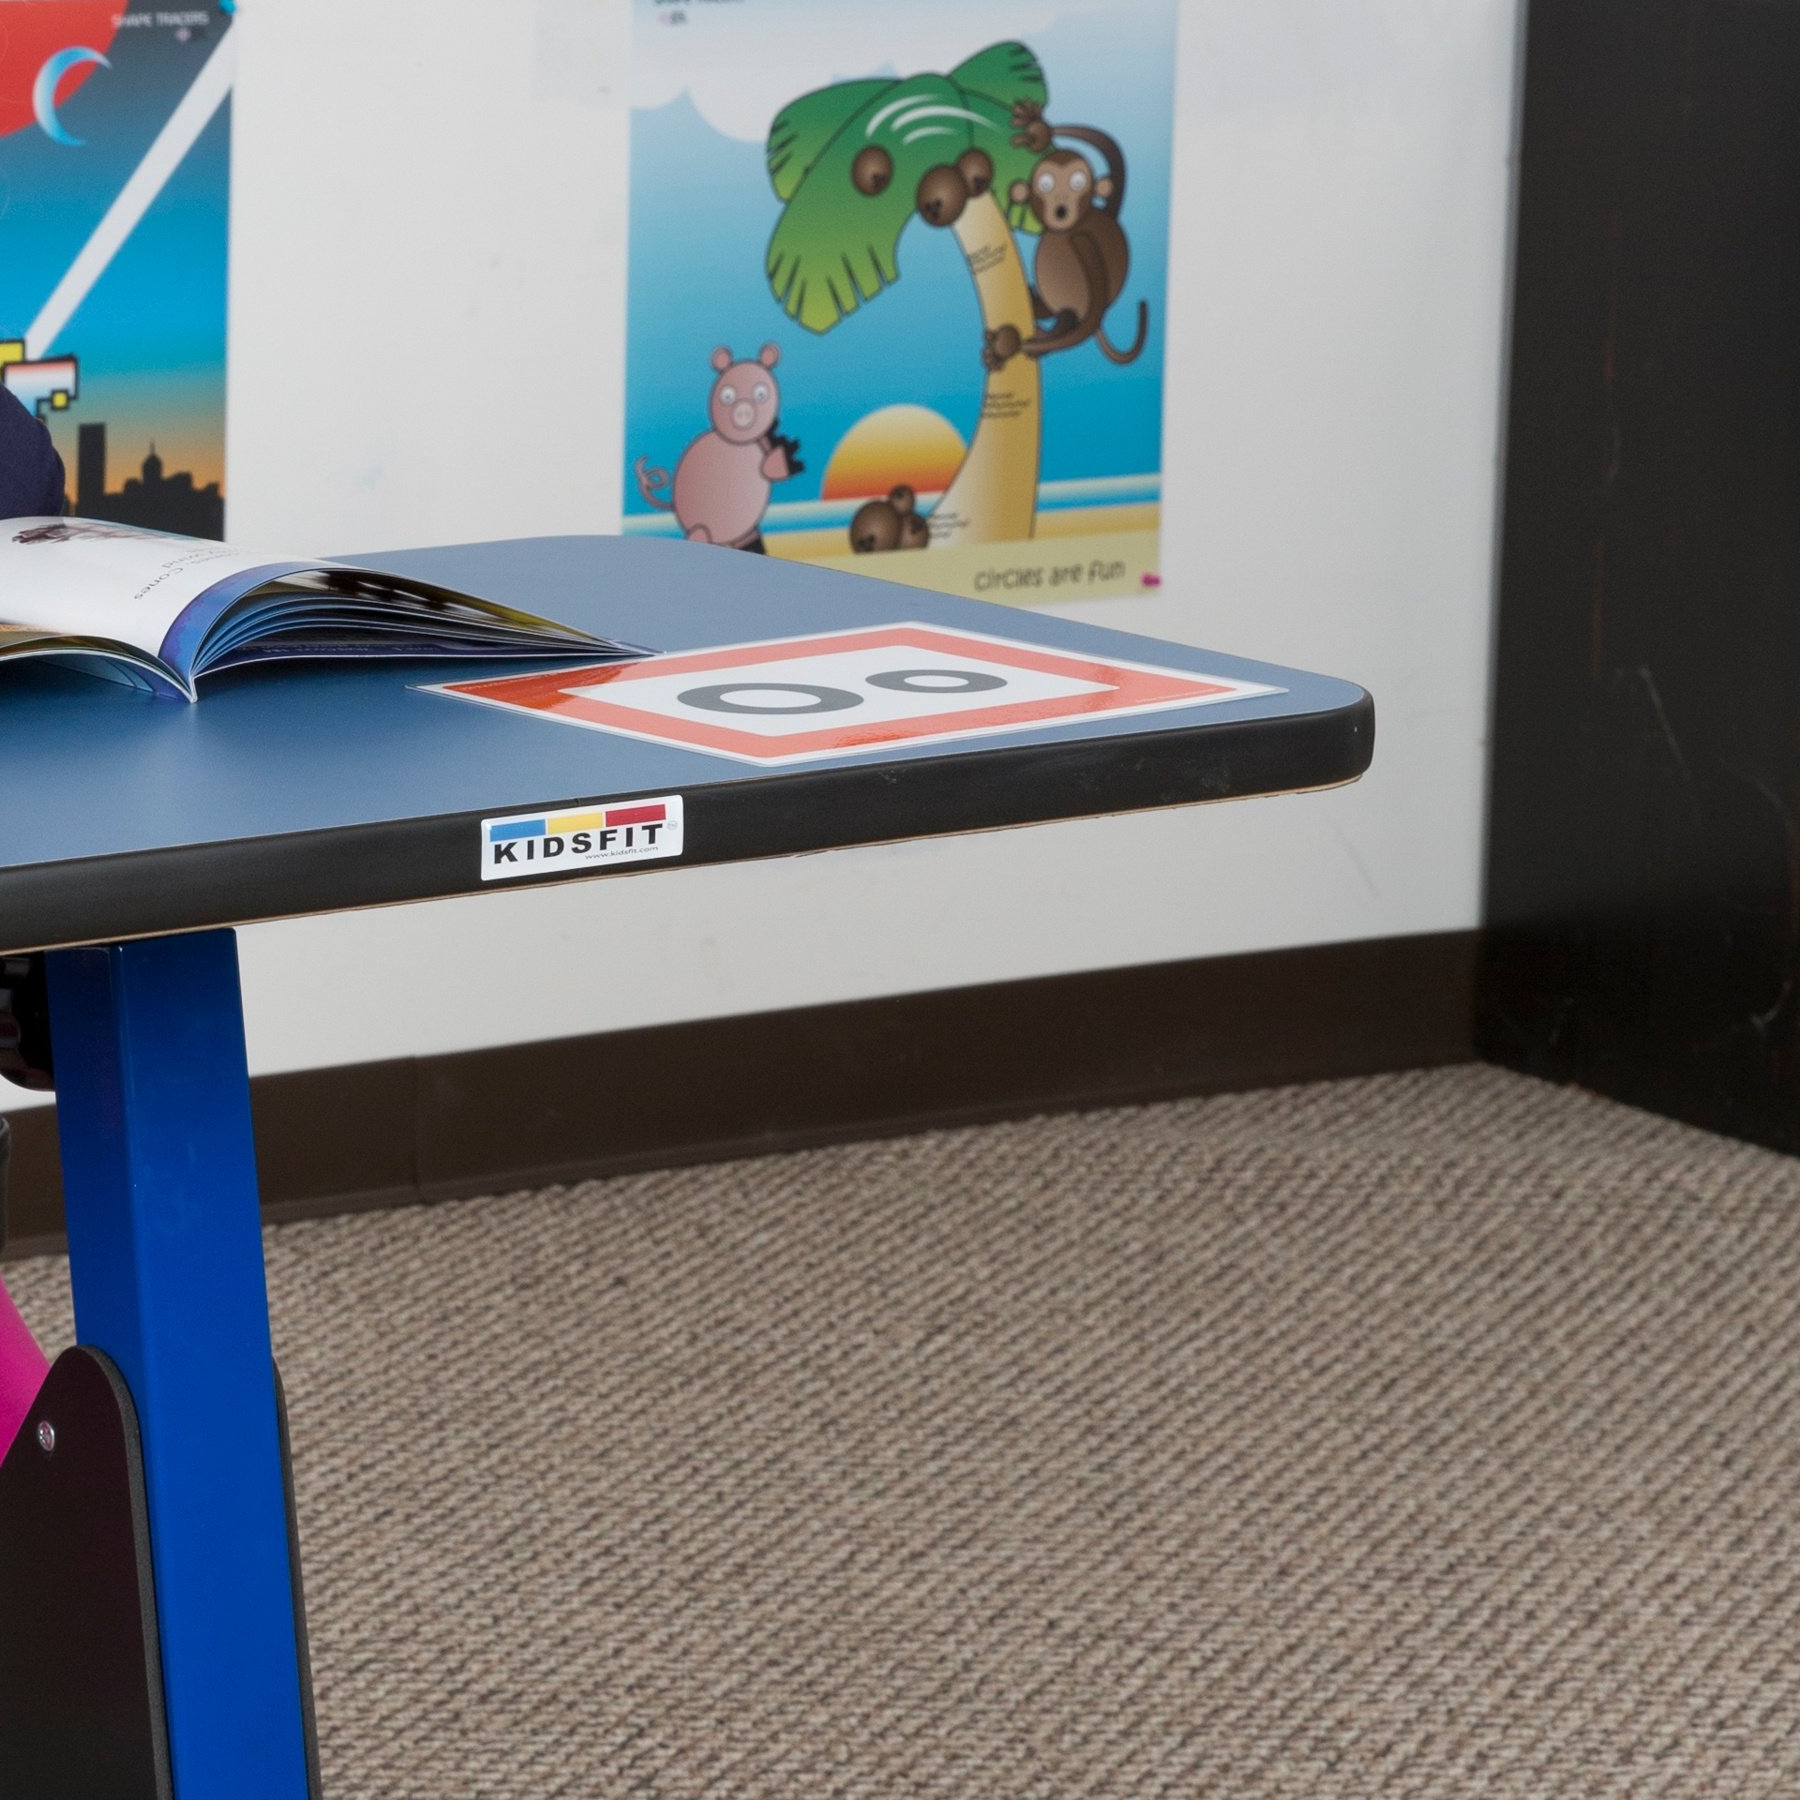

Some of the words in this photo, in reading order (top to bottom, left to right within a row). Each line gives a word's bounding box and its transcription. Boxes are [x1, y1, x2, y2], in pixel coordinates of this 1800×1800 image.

[1049, 562, 1083, 587] are
[1087, 559, 1126, 585] fun
[494, 823, 663, 865] KIDSFIT
[585, 846, 659, 861] www.kidsfit.com
